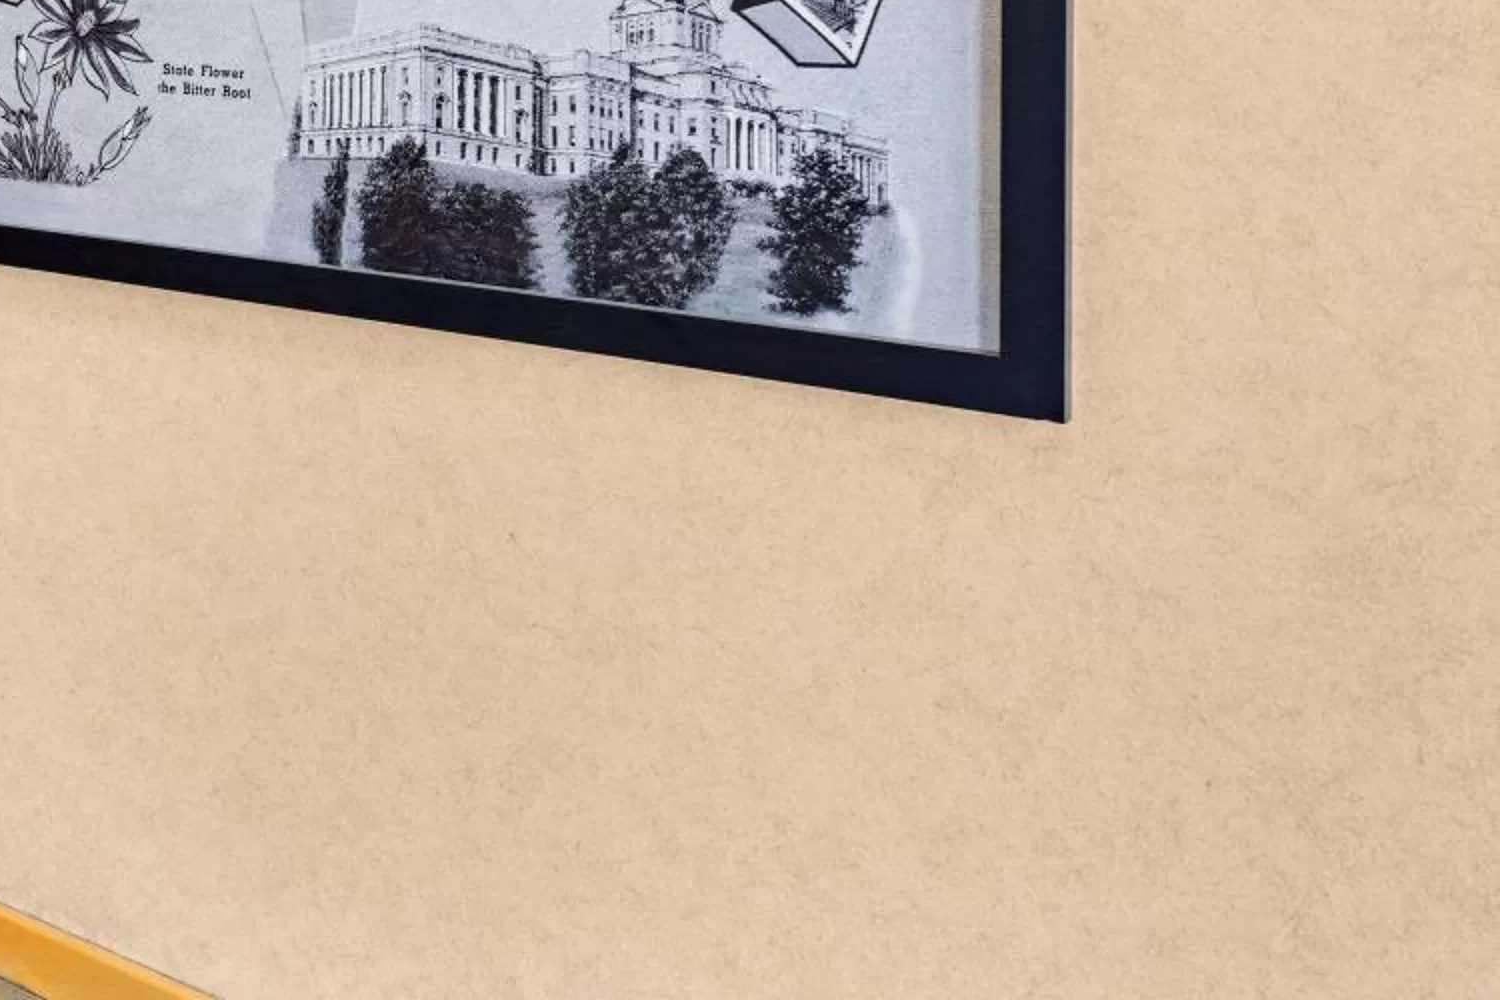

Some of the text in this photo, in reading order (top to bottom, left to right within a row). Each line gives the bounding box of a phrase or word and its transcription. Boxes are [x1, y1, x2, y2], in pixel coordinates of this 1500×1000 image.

[163, 62, 245, 79] State Flower
[157, 80, 177, 95] the
